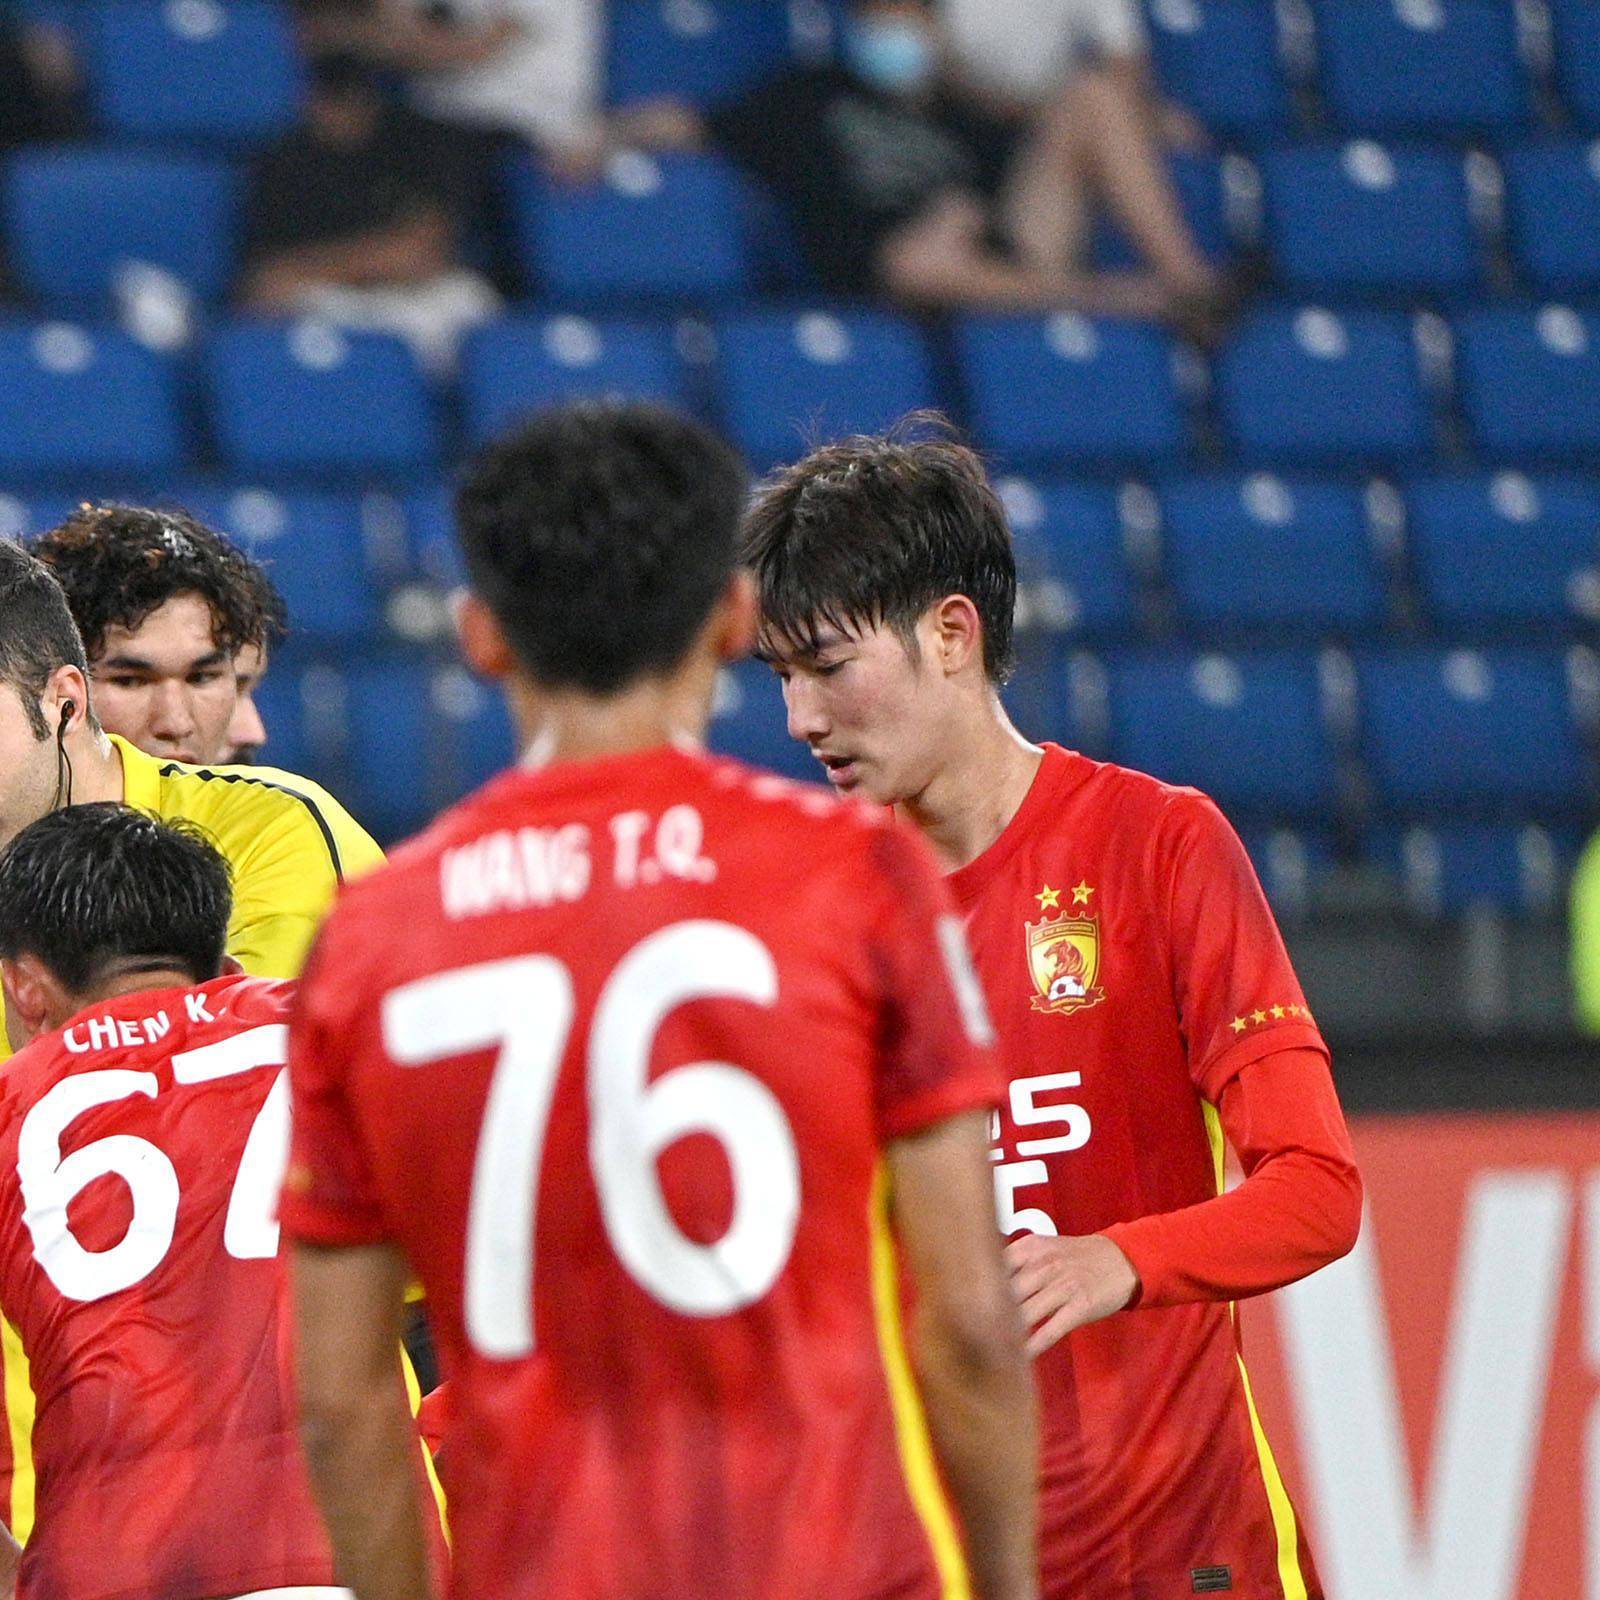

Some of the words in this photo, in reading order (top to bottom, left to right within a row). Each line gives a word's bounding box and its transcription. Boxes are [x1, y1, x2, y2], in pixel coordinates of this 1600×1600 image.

[440, 822, 592, 921] WANG
[63, 1010, 170, 1053] CHEN
[17, 1023, 290, 1301] 67
[382, 919, 800, 1360] 76
